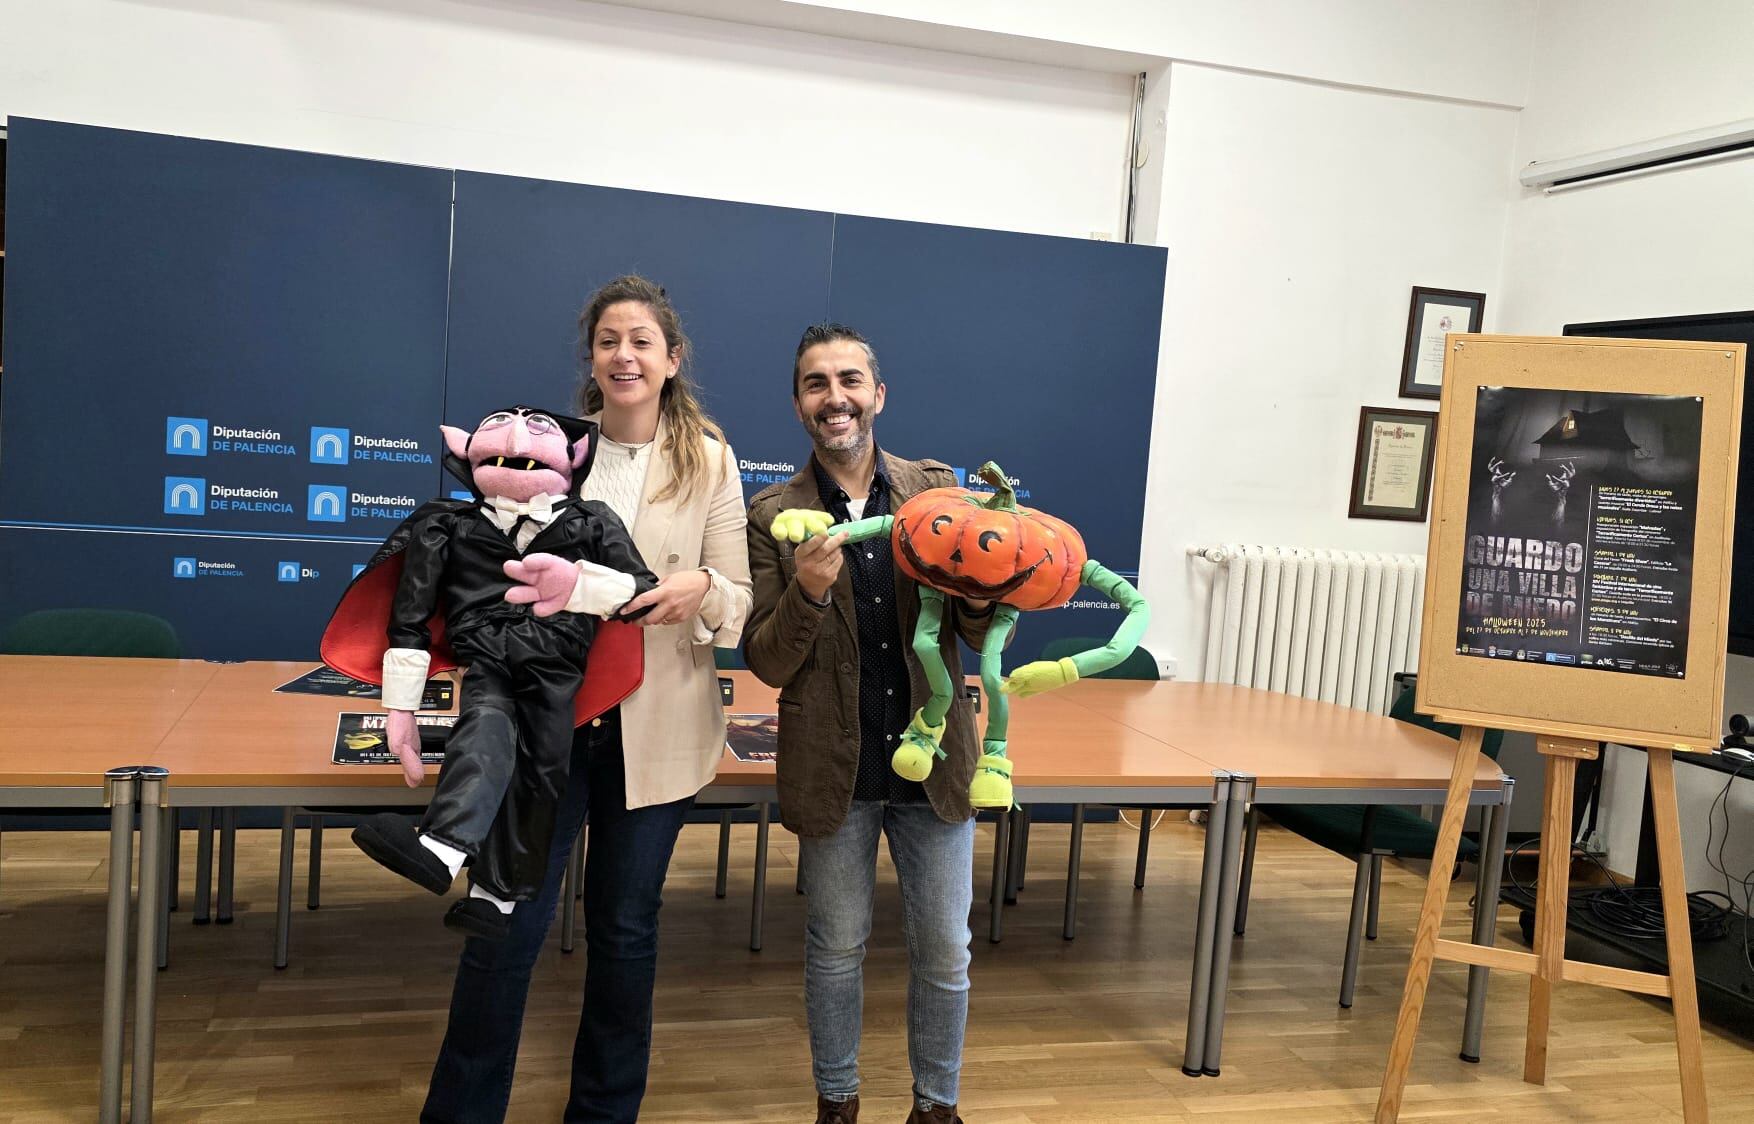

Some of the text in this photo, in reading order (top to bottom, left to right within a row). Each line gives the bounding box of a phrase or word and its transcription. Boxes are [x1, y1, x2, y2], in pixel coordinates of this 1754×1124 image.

[213, 426, 281, 440] Diputación
[213, 441, 296, 456] DE PALENCIA
[354, 435, 418, 450] Diputación
[354, 450, 433, 464] DE PALENCIA
[740, 460, 794, 472] Diputación
[211, 485, 279, 499] Diputación
[210, 499, 293, 514] DE PALENCIA
[351, 493, 416, 506] Diputación
[351, 507, 368, 517] DE
[1467, 534, 1583, 573] GUARDO
[198, 561, 236, 569] Diputación
[209, 569, 244, 577] PALENCIA
[1468, 567, 1577, 599] UNA VILLA
[1466, 591, 1577, 621] DE MIEDO
[1526, 618, 1546, 628] 2025
